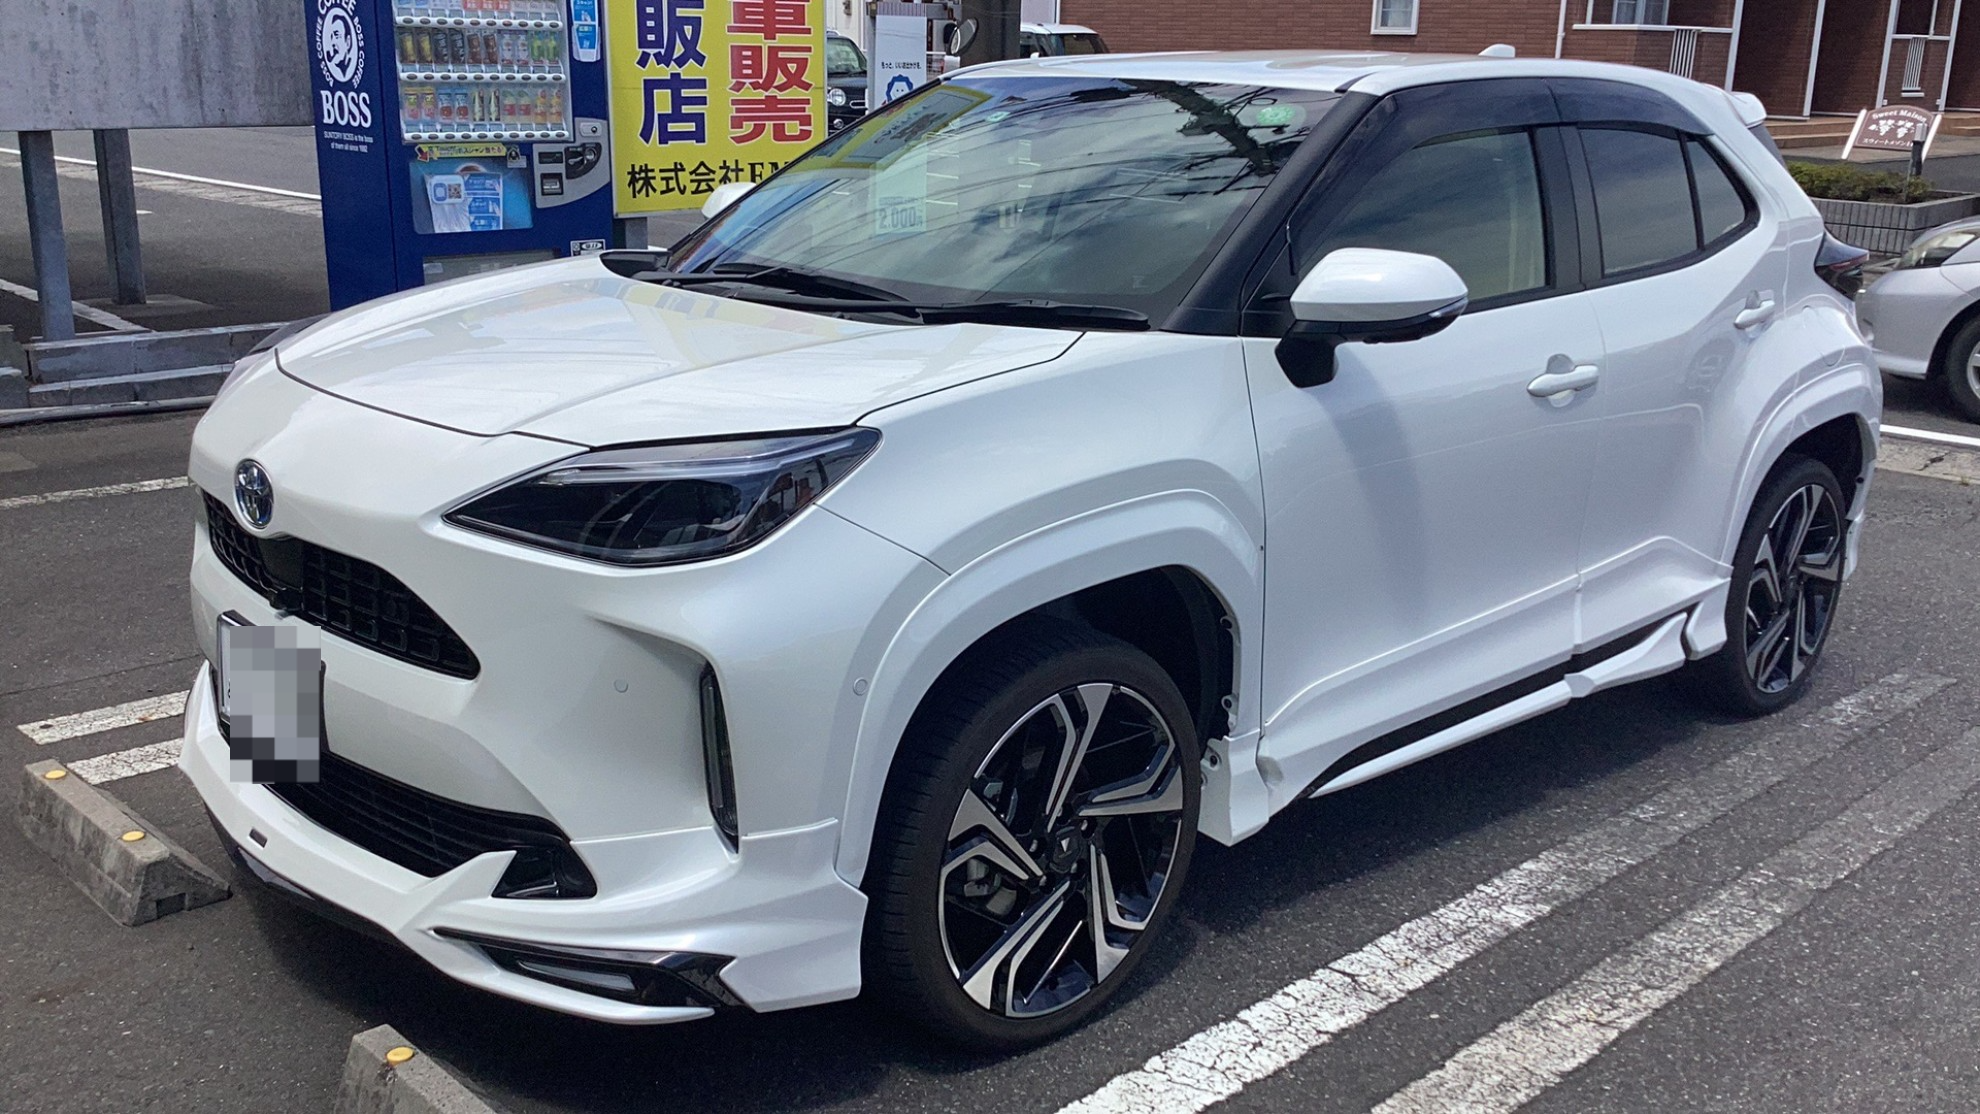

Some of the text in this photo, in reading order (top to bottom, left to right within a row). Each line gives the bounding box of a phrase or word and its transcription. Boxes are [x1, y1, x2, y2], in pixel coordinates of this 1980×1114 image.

[320, 90, 372, 128] BOSS
[1872, 109, 1927, 122] Sweet Maison
